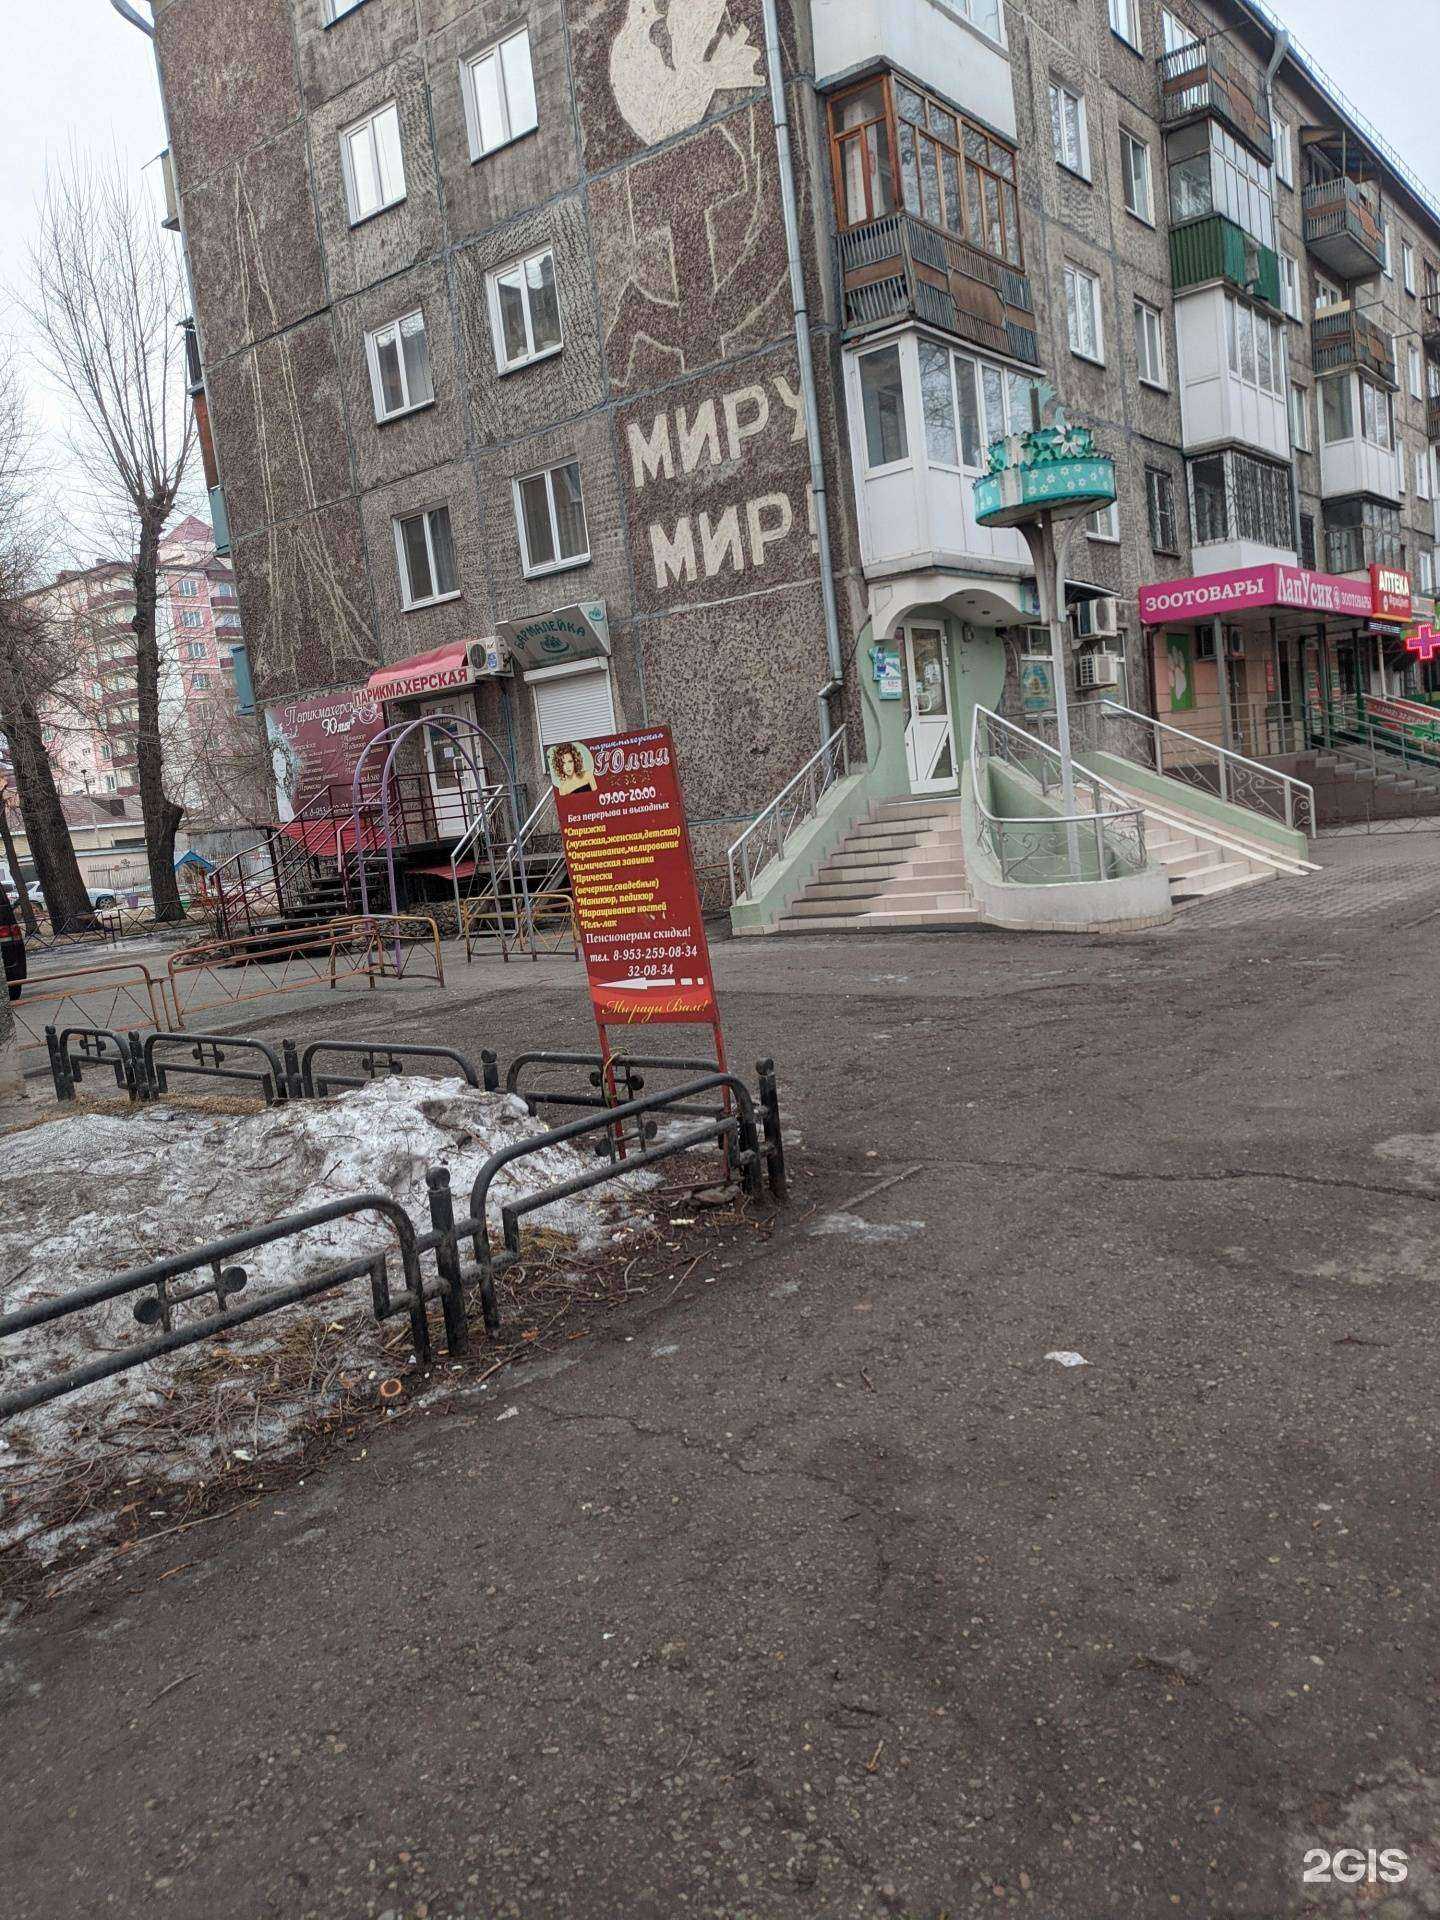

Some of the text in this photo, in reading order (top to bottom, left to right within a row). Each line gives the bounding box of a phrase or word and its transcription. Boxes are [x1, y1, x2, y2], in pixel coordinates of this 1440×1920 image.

[627, 376, 807, 488] МИРУ
[1277, 568, 1334, 609] ЛапУсик
[1379, 570, 1410, 597] АПТЕКА
[1145, 577, 1265, 612] ЗООТОВАРЫ
[353, 668, 468, 708] ПАРИКМАХЕРСКАЯ
[284, 702, 354, 726] Парикмахерск
[590, 733, 664, 751] парикмахерская
[594, 747, 670, 776] Юлия
[599, 786, 656, 805] 09:00-20:00
[567, 814, 581, 823] Без
[582, 809, 621, 821] перерыва
[629, 802, 670, 813] выходных
[622, 856, 655, 866] завивка
[619, 892, 654, 902] педикюр
[582, 901, 667, 919] Наращивание ногтей
[584, 919, 617, 929] Гель-лак
[585, 926, 692, 944] Пенсионерам скидка!
[590, 945, 698, 962] тел. 8-953-259-08-34
[627, 963, 674, 977] 32-08-34
[601, 1000, 708, 1024] Мы рады Вам!
